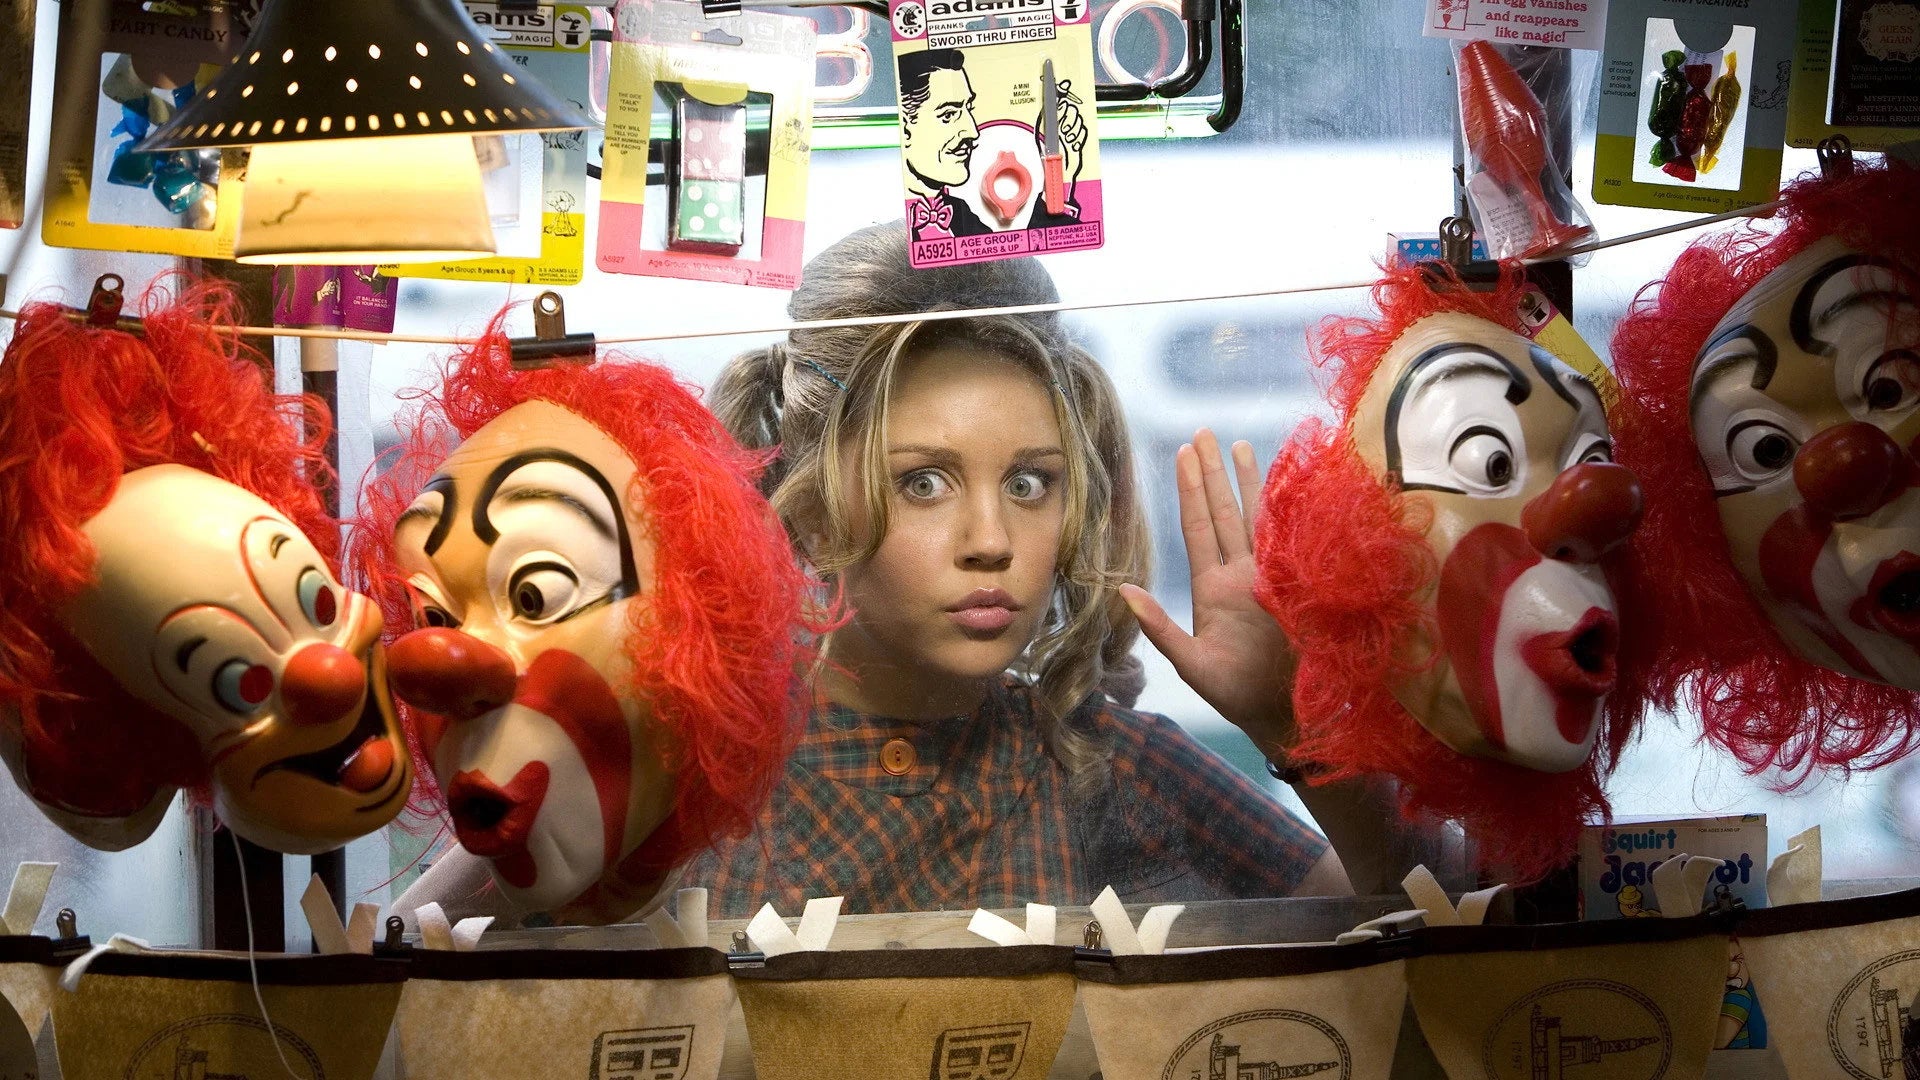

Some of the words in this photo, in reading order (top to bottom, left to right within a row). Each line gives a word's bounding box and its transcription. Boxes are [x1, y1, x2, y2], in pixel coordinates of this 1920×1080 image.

[1504, 0, 1526, 8] egg
[1530, 0, 1588, 12] vanishes
[928, 22, 964, 31] PRANKS
[1018, 14, 1051, 23] MAGIC
[1485, 10, 1510, 22] and
[1514, 14, 1579, 28] reappears
[165, 25, 227, 42] CANDY
[1495, 26, 1519, 39] like
[1879, 25, 1913, 34] GUESS
[515, 35, 551, 43] MAGIC
[930, 34, 973, 47] SWORD
[977, 31, 1007, 43] THRU
[1011, 27, 1053, 39] FINGER
[1879, 35, 1912, 44] AGAIN
[1060, 226, 1084, 235] ADAMS
[1085, 225, 1098, 233] LLC
[960, 237, 982, 248] AGE
[984, 233, 1023, 245] GROUP:
[917, 242, 953, 260] A5925
[970, 247, 998, 256] YEARS
[1008, 244, 1019, 252] UP
[602, 255, 625, 264] A5927
[648, 259, 663, 268] Age
[441, 265, 454, 273] Age
[455, 266, 476, 274] Group:
[361, 296, 388, 304] BALANCES
[1602, 829, 1677, 854] Squirt
[1600, 853, 1753, 893] Jaot
[1855, 1016, 1869, 1047] 1797
